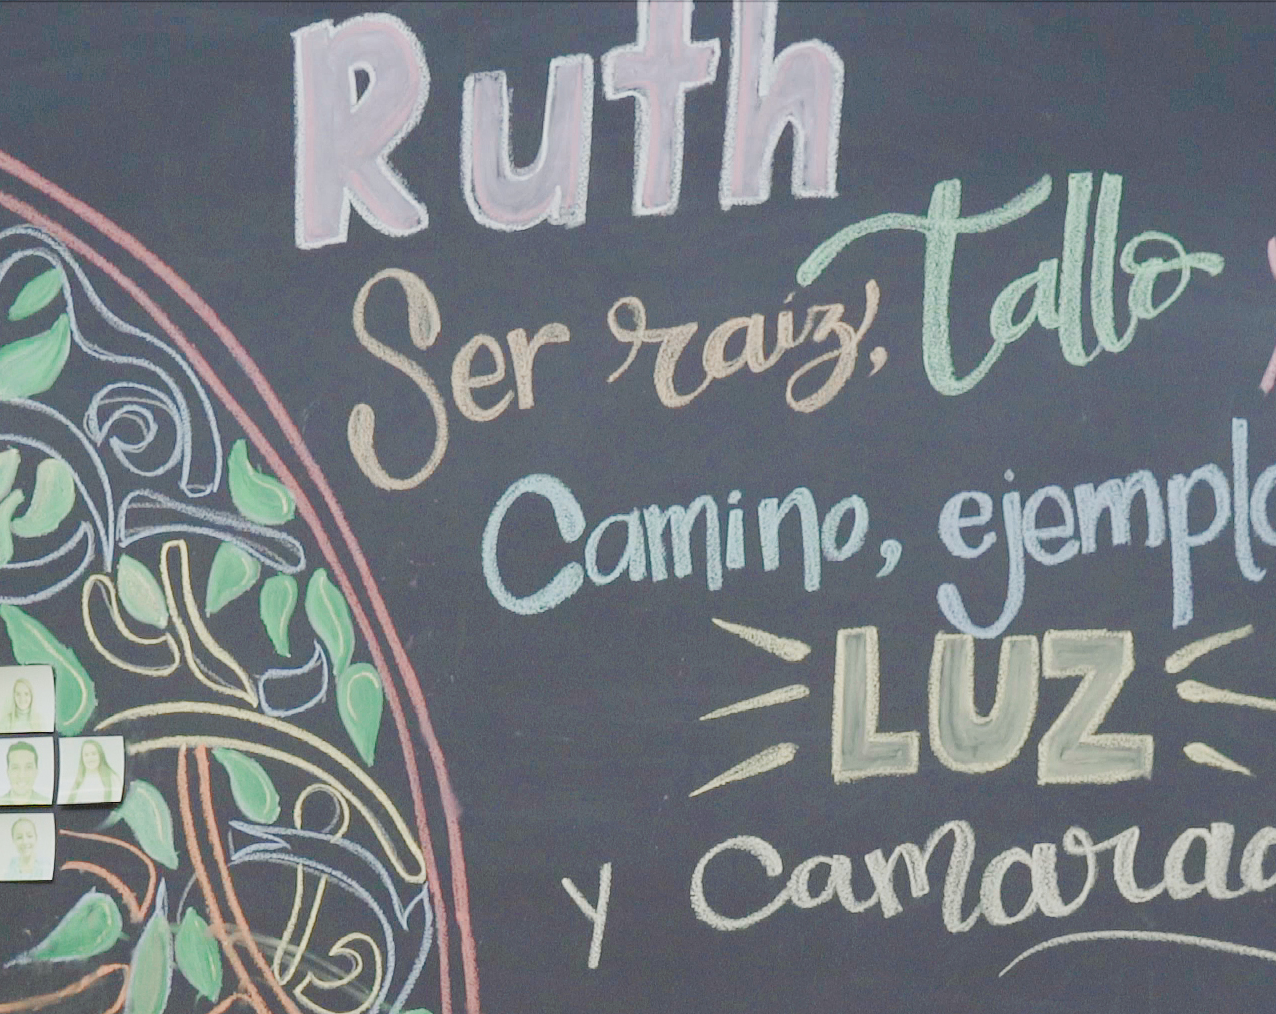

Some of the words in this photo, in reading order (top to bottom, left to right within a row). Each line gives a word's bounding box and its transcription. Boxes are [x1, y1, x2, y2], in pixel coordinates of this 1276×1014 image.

[294, 0, 845, 250] Ruth
[347, 268, 569, 490] Ser
[481, 473, 902, 615] Camino,
[831, 625, 1154, 786] LUZ
[561, 862, 612, 969] y
